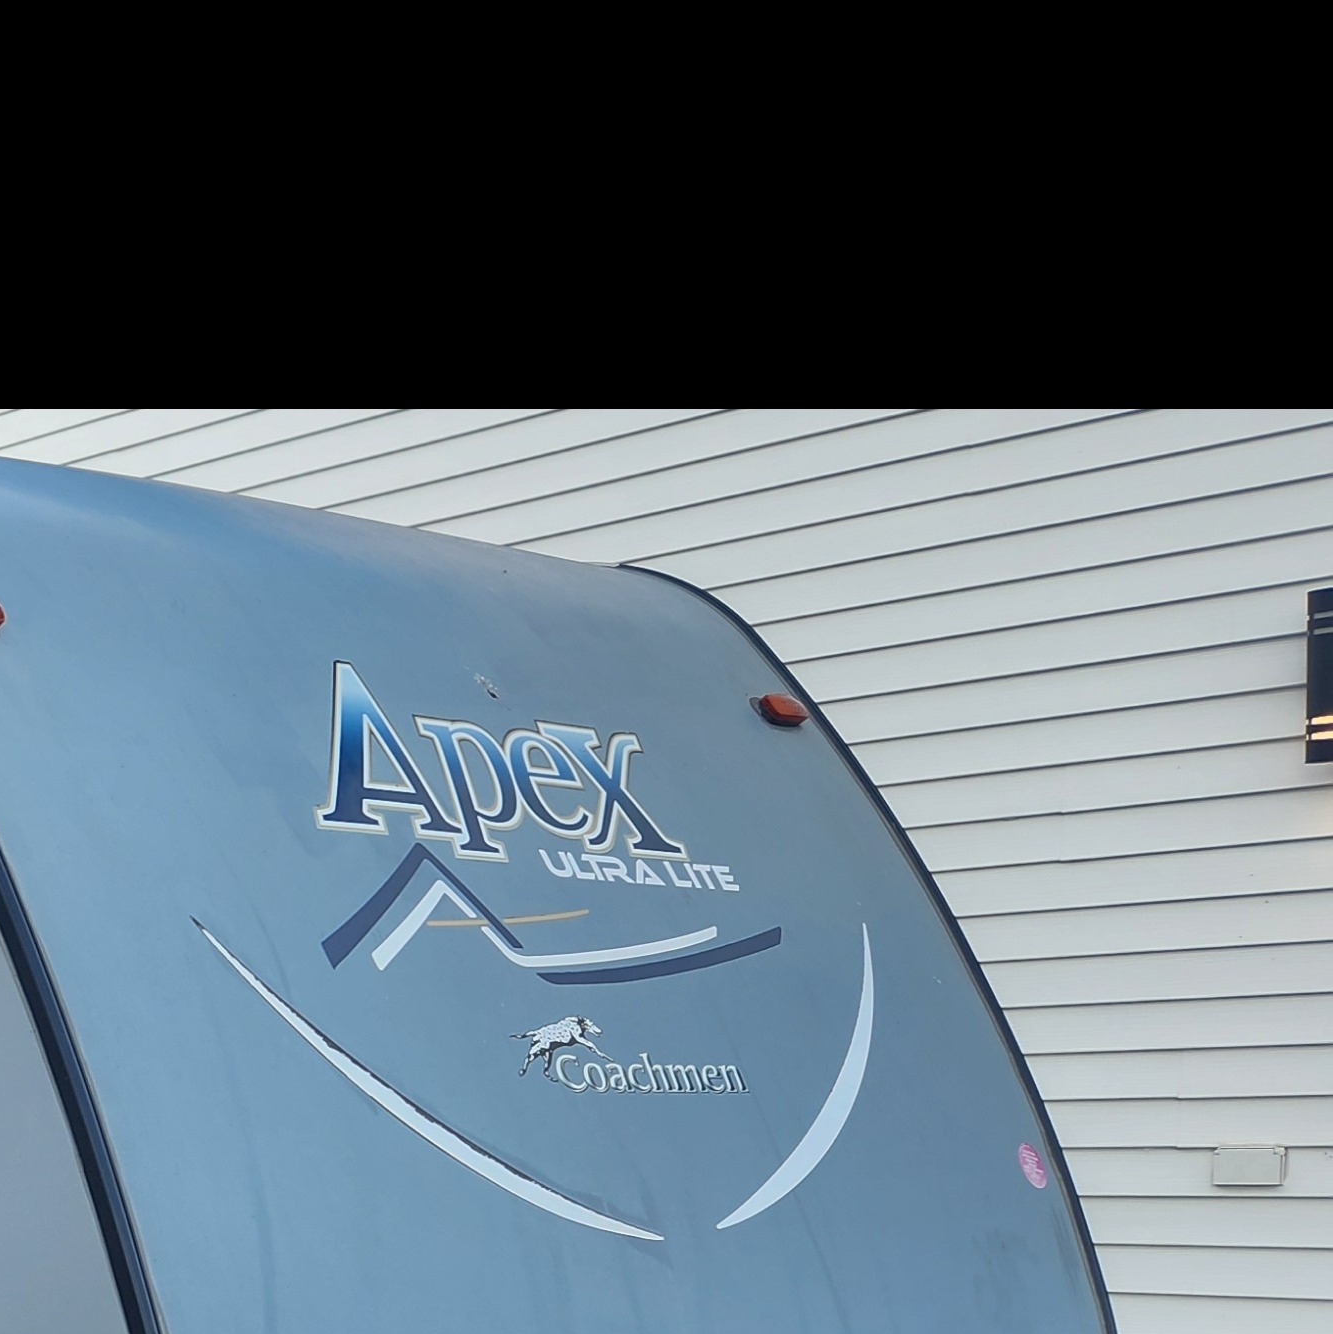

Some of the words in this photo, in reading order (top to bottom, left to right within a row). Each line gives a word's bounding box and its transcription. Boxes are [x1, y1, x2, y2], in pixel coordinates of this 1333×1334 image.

[316, 659, 686, 862] Apex
[538, 849, 666, 886] ULTRA
[663, 861, 740, 892] LITE
[554, 1053, 751, 1096] Coachmen
